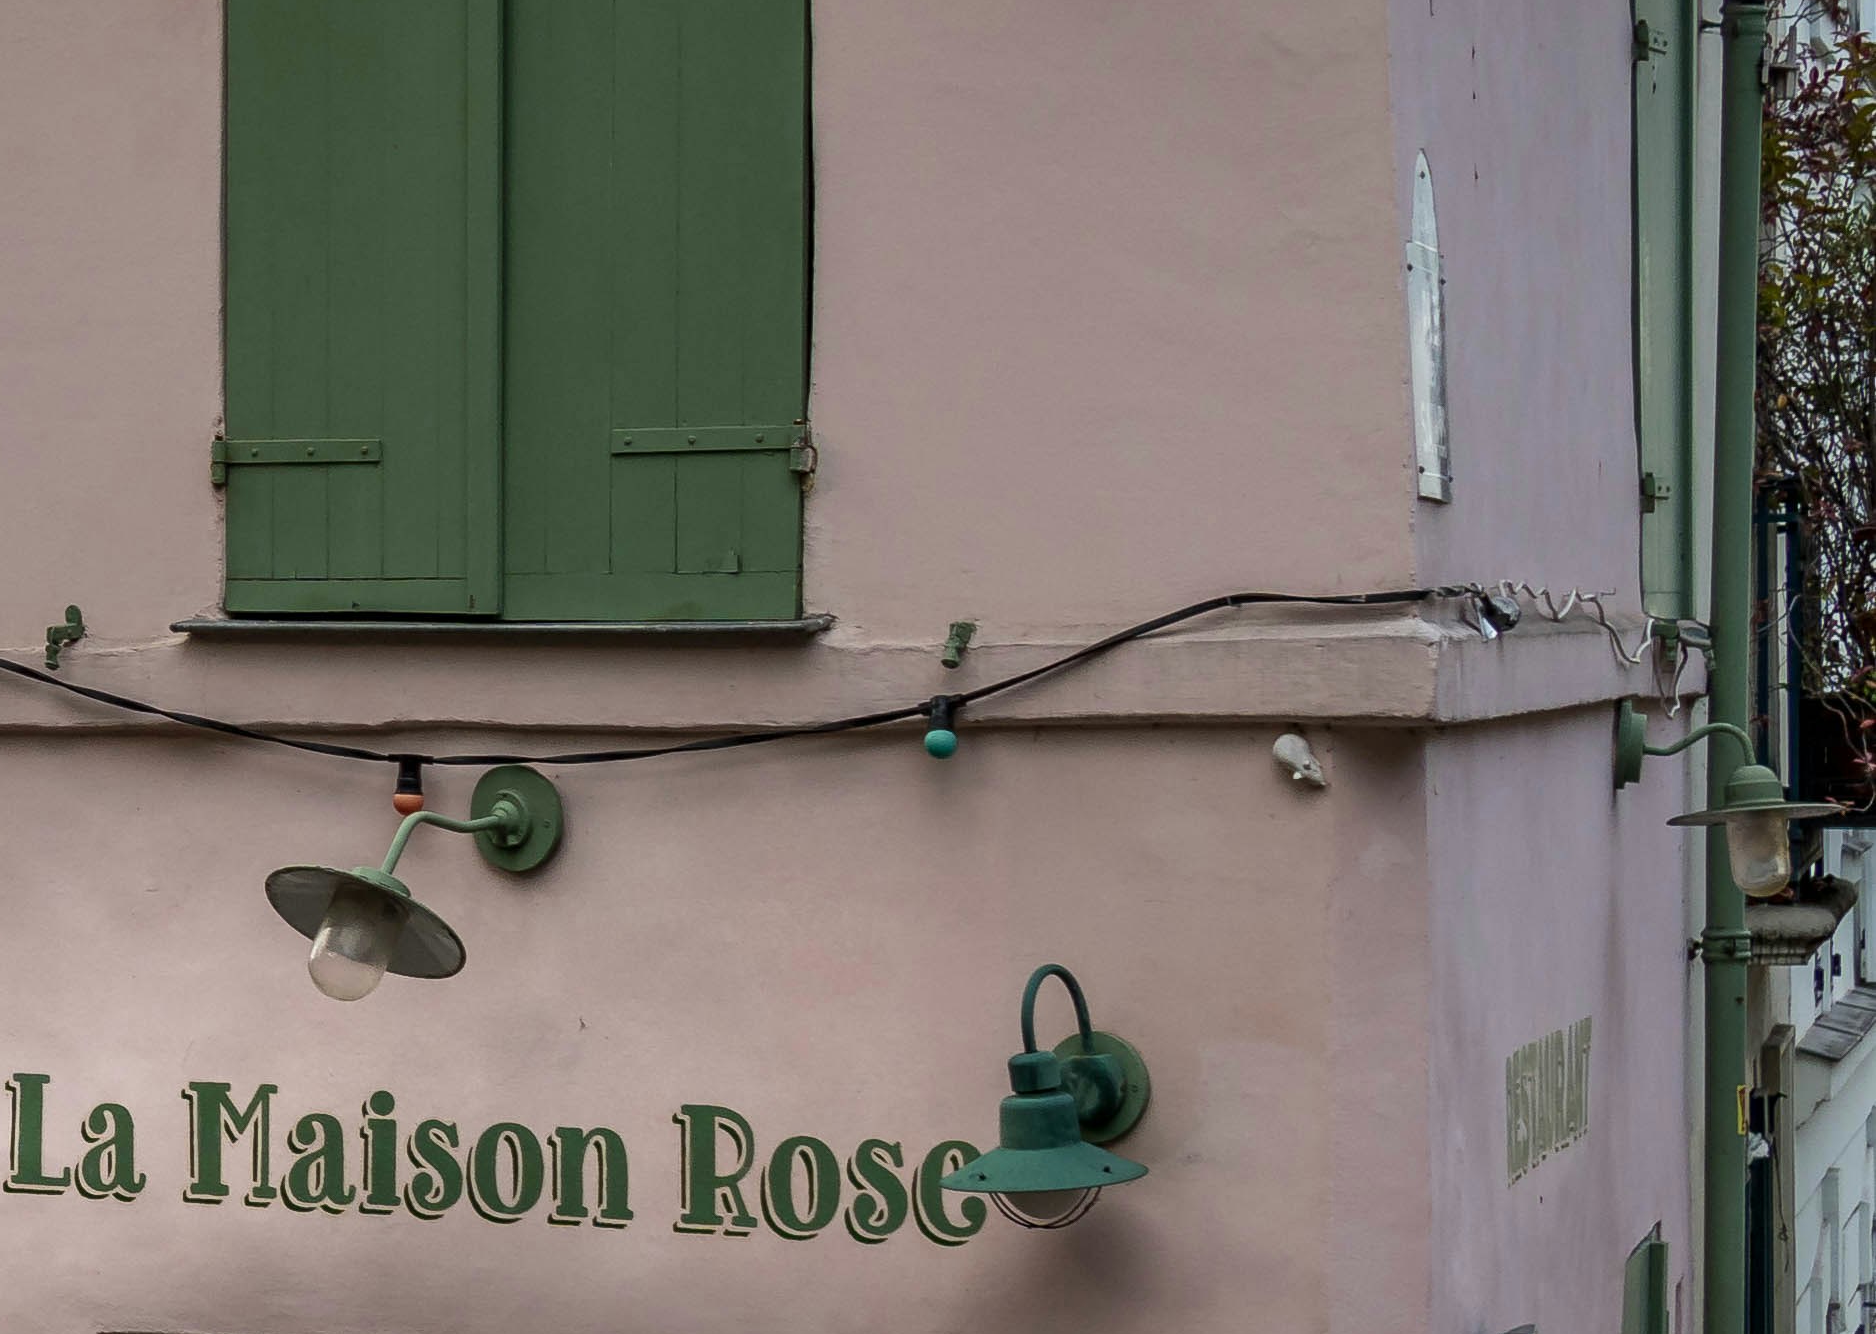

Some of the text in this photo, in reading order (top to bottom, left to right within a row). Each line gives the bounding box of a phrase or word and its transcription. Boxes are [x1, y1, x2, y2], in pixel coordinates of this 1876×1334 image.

[2, 1070, 989, 1247] La Maison Rose
